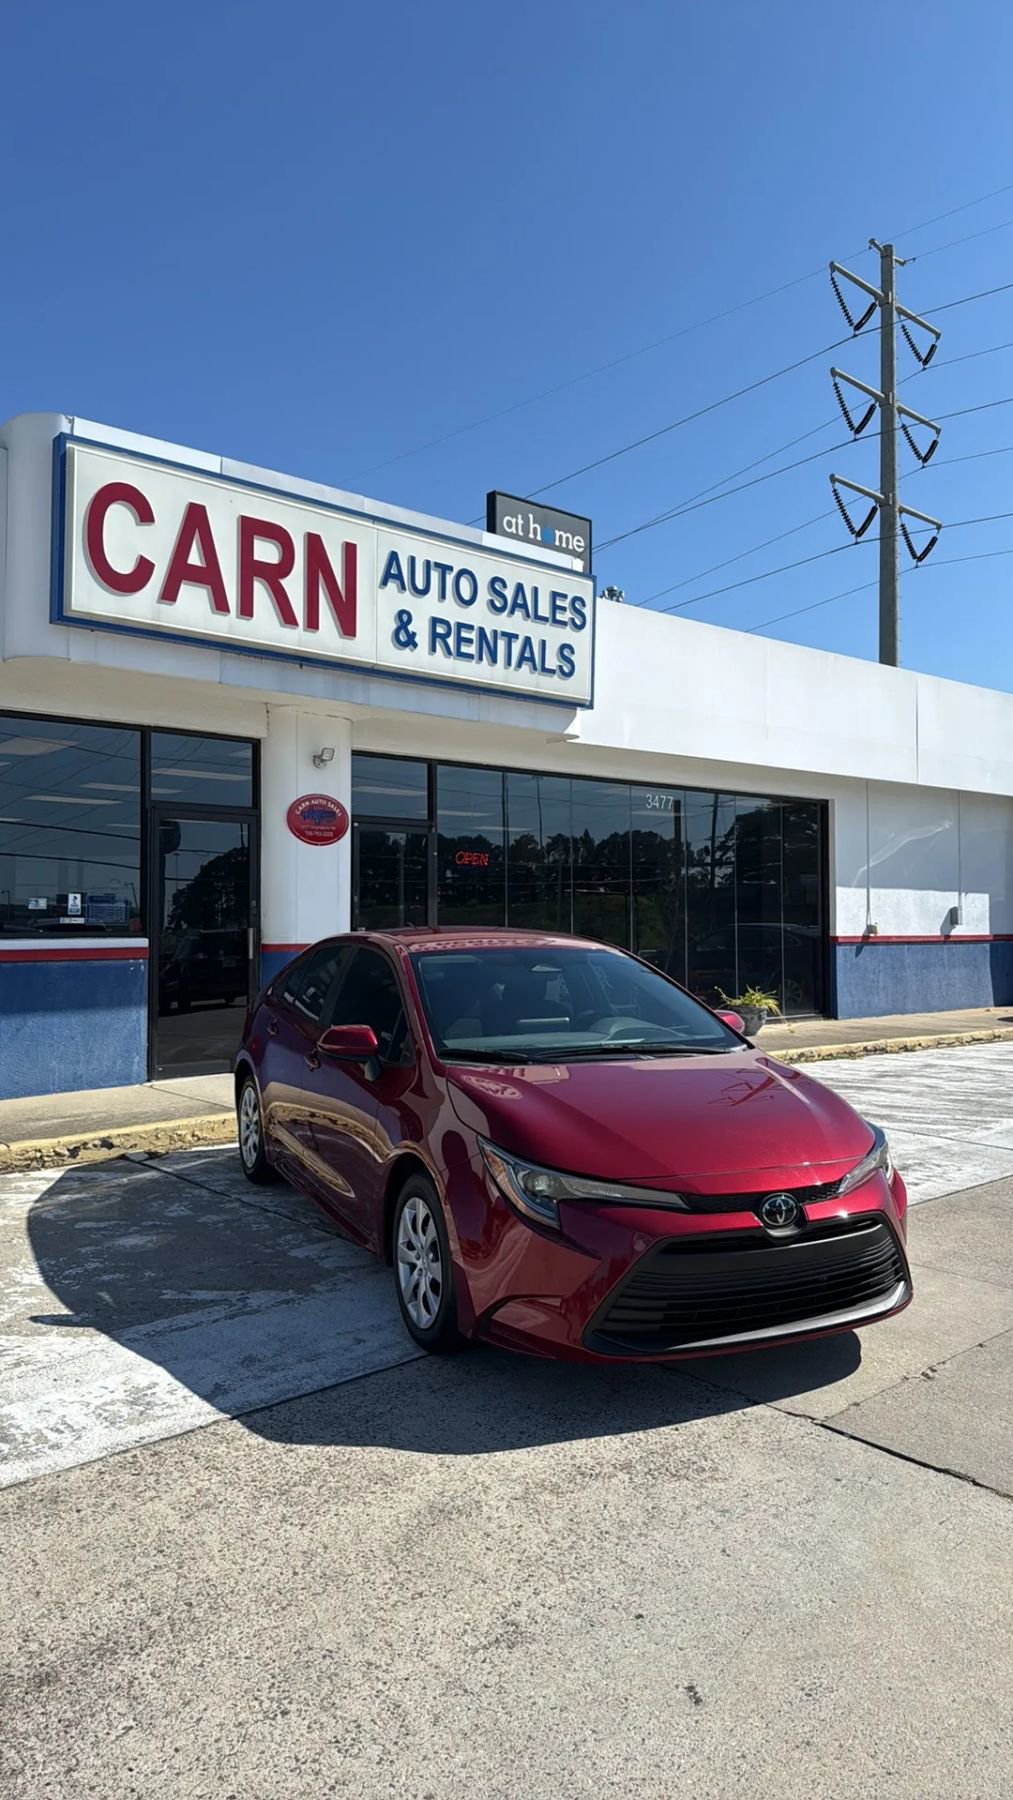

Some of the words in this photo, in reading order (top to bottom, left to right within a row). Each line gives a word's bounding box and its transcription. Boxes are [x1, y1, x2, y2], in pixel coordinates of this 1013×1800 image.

[83, 481, 357, 639] CARN
[503, 514, 524, 536] at
[528, 513, 585, 552] hme
[379, 550, 478, 608] AUTO
[486, 576, 587, 632] SALES
[391, 609, 418, 651] &
[428, 616, 576, 681] RENTALS
[645, 793, 674, 809] 3477
[455, 850, 489, 866] OPEN
